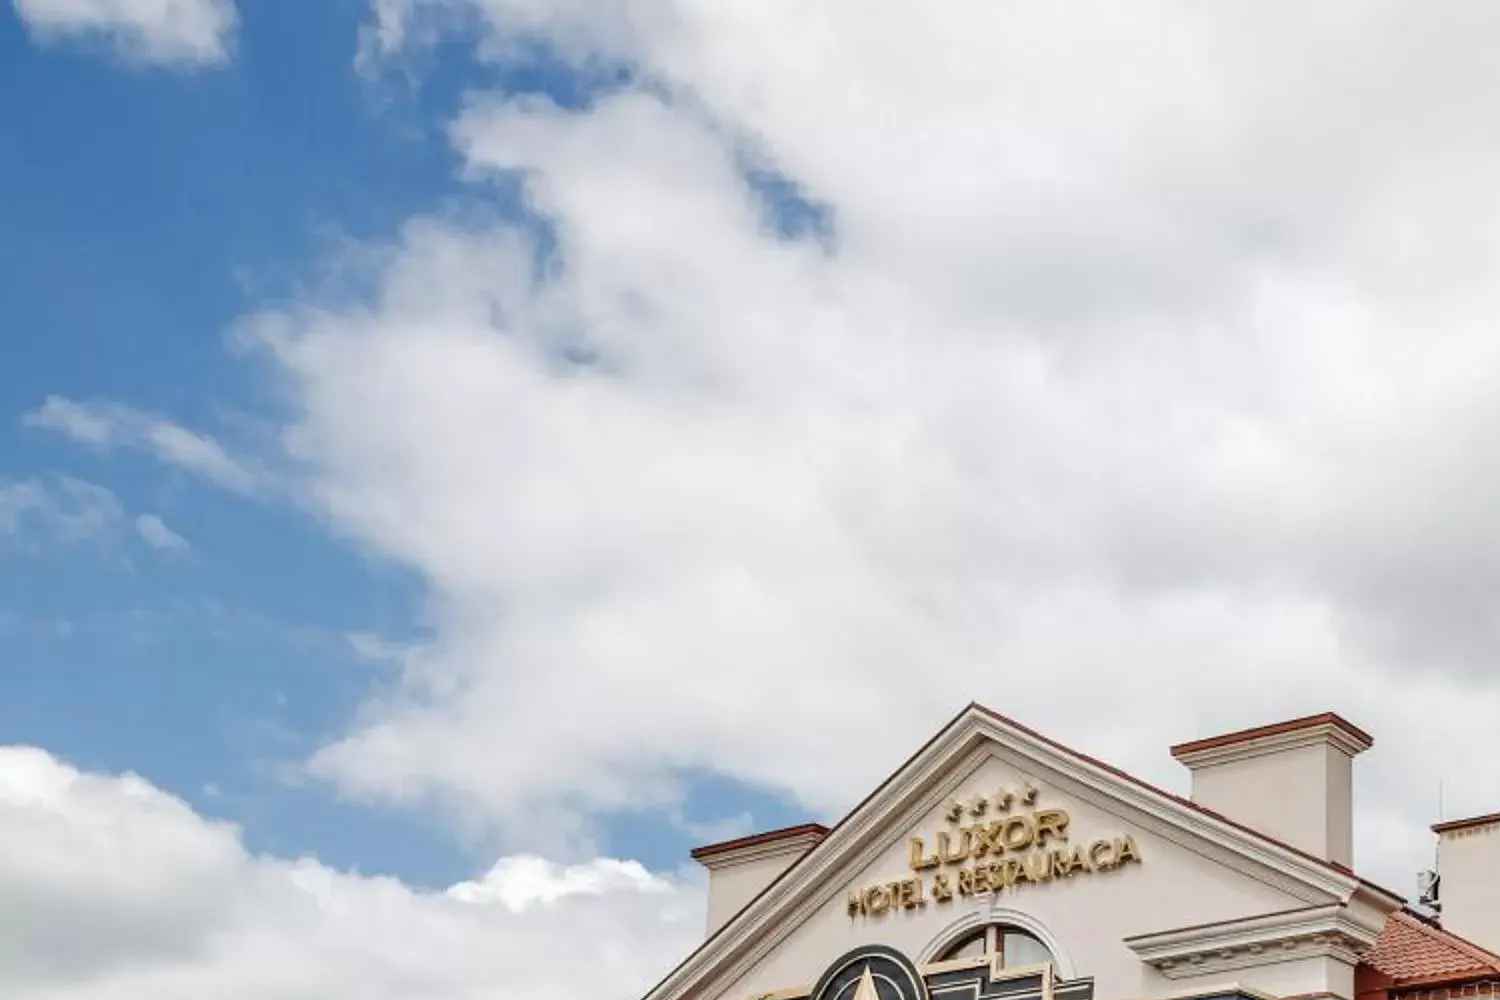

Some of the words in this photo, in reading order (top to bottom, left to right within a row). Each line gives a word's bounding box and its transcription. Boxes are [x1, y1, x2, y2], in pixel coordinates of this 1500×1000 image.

[848, 877, 926, 917] HOTEL
[931, 873, 952, 903] &
[958, 834, 1142, 896] RESTAURACJA
[909, 809, 1070, 870] LUXOR
